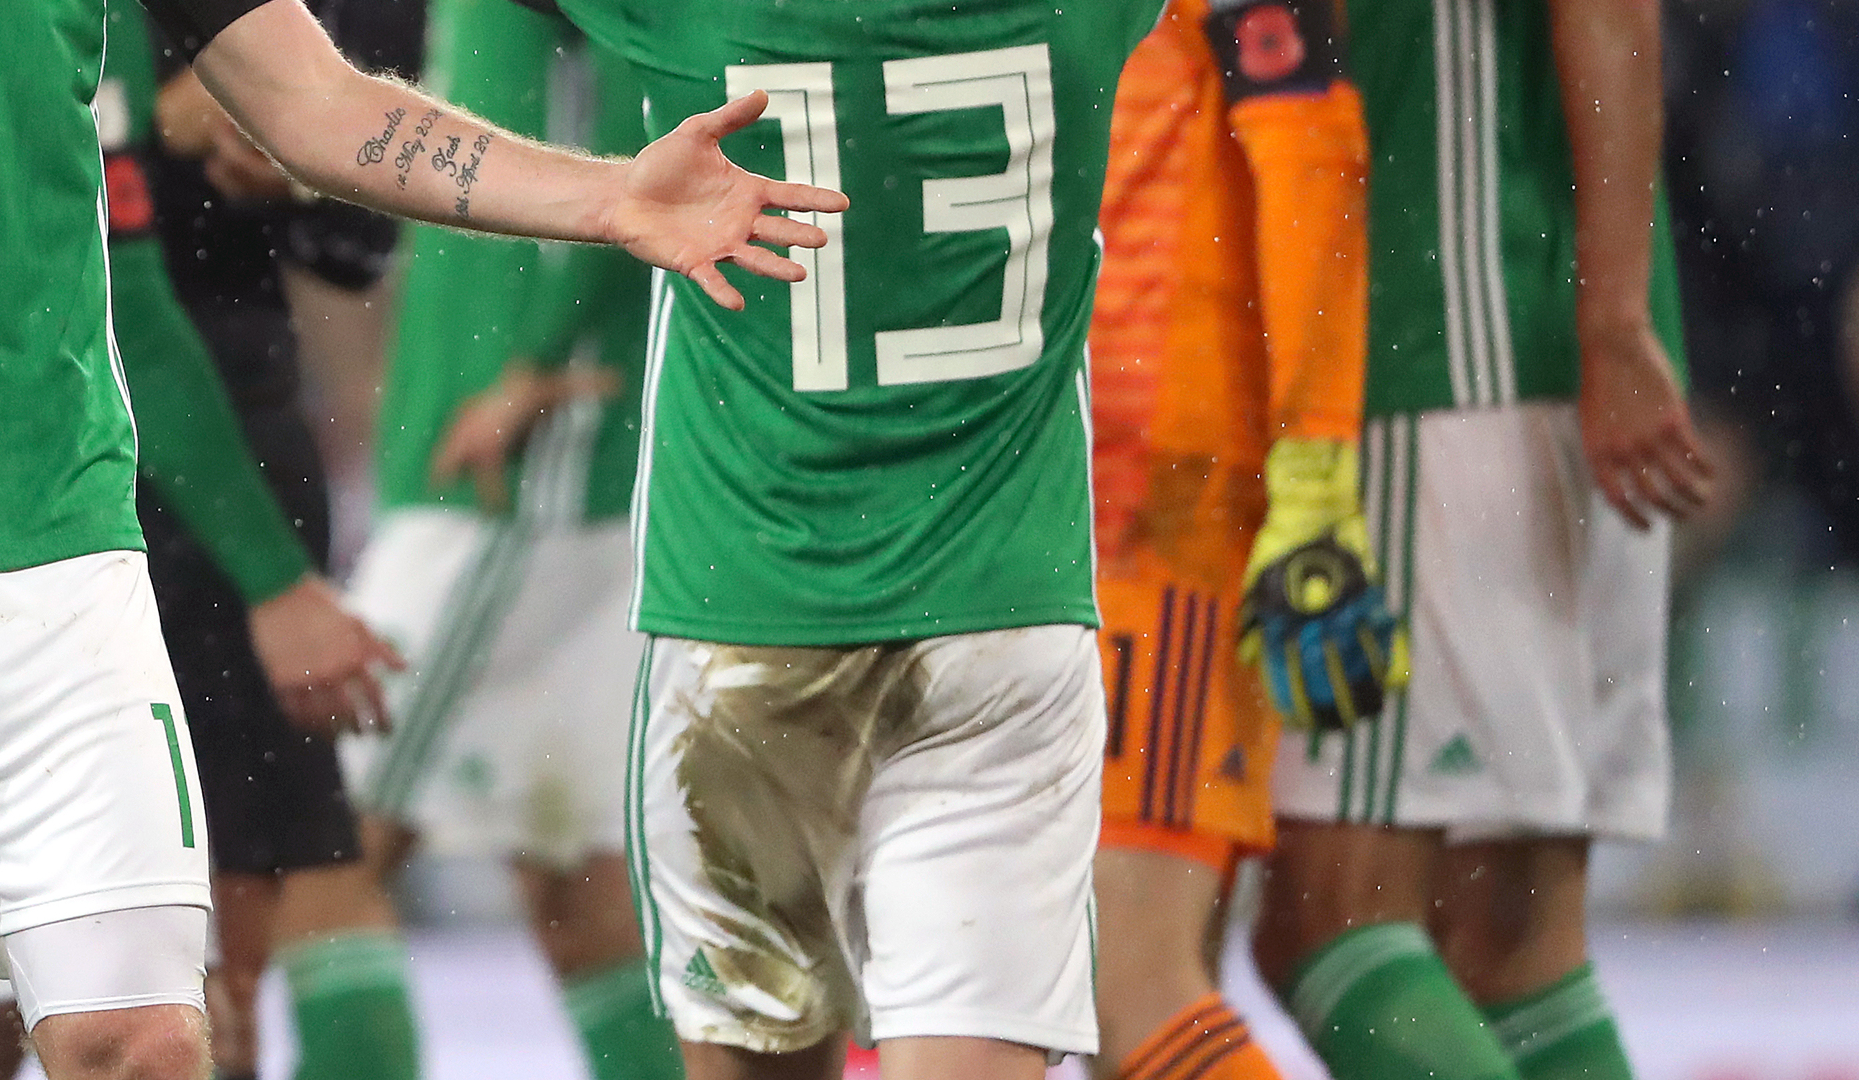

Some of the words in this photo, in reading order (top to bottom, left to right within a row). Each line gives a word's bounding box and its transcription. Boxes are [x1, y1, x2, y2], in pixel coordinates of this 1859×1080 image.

[357, 107, 406, 166] Charlie
[395, 138, 425, 173] May
[725, 42, 1056, 392] 13
[150, 702, 195, 849] 1
